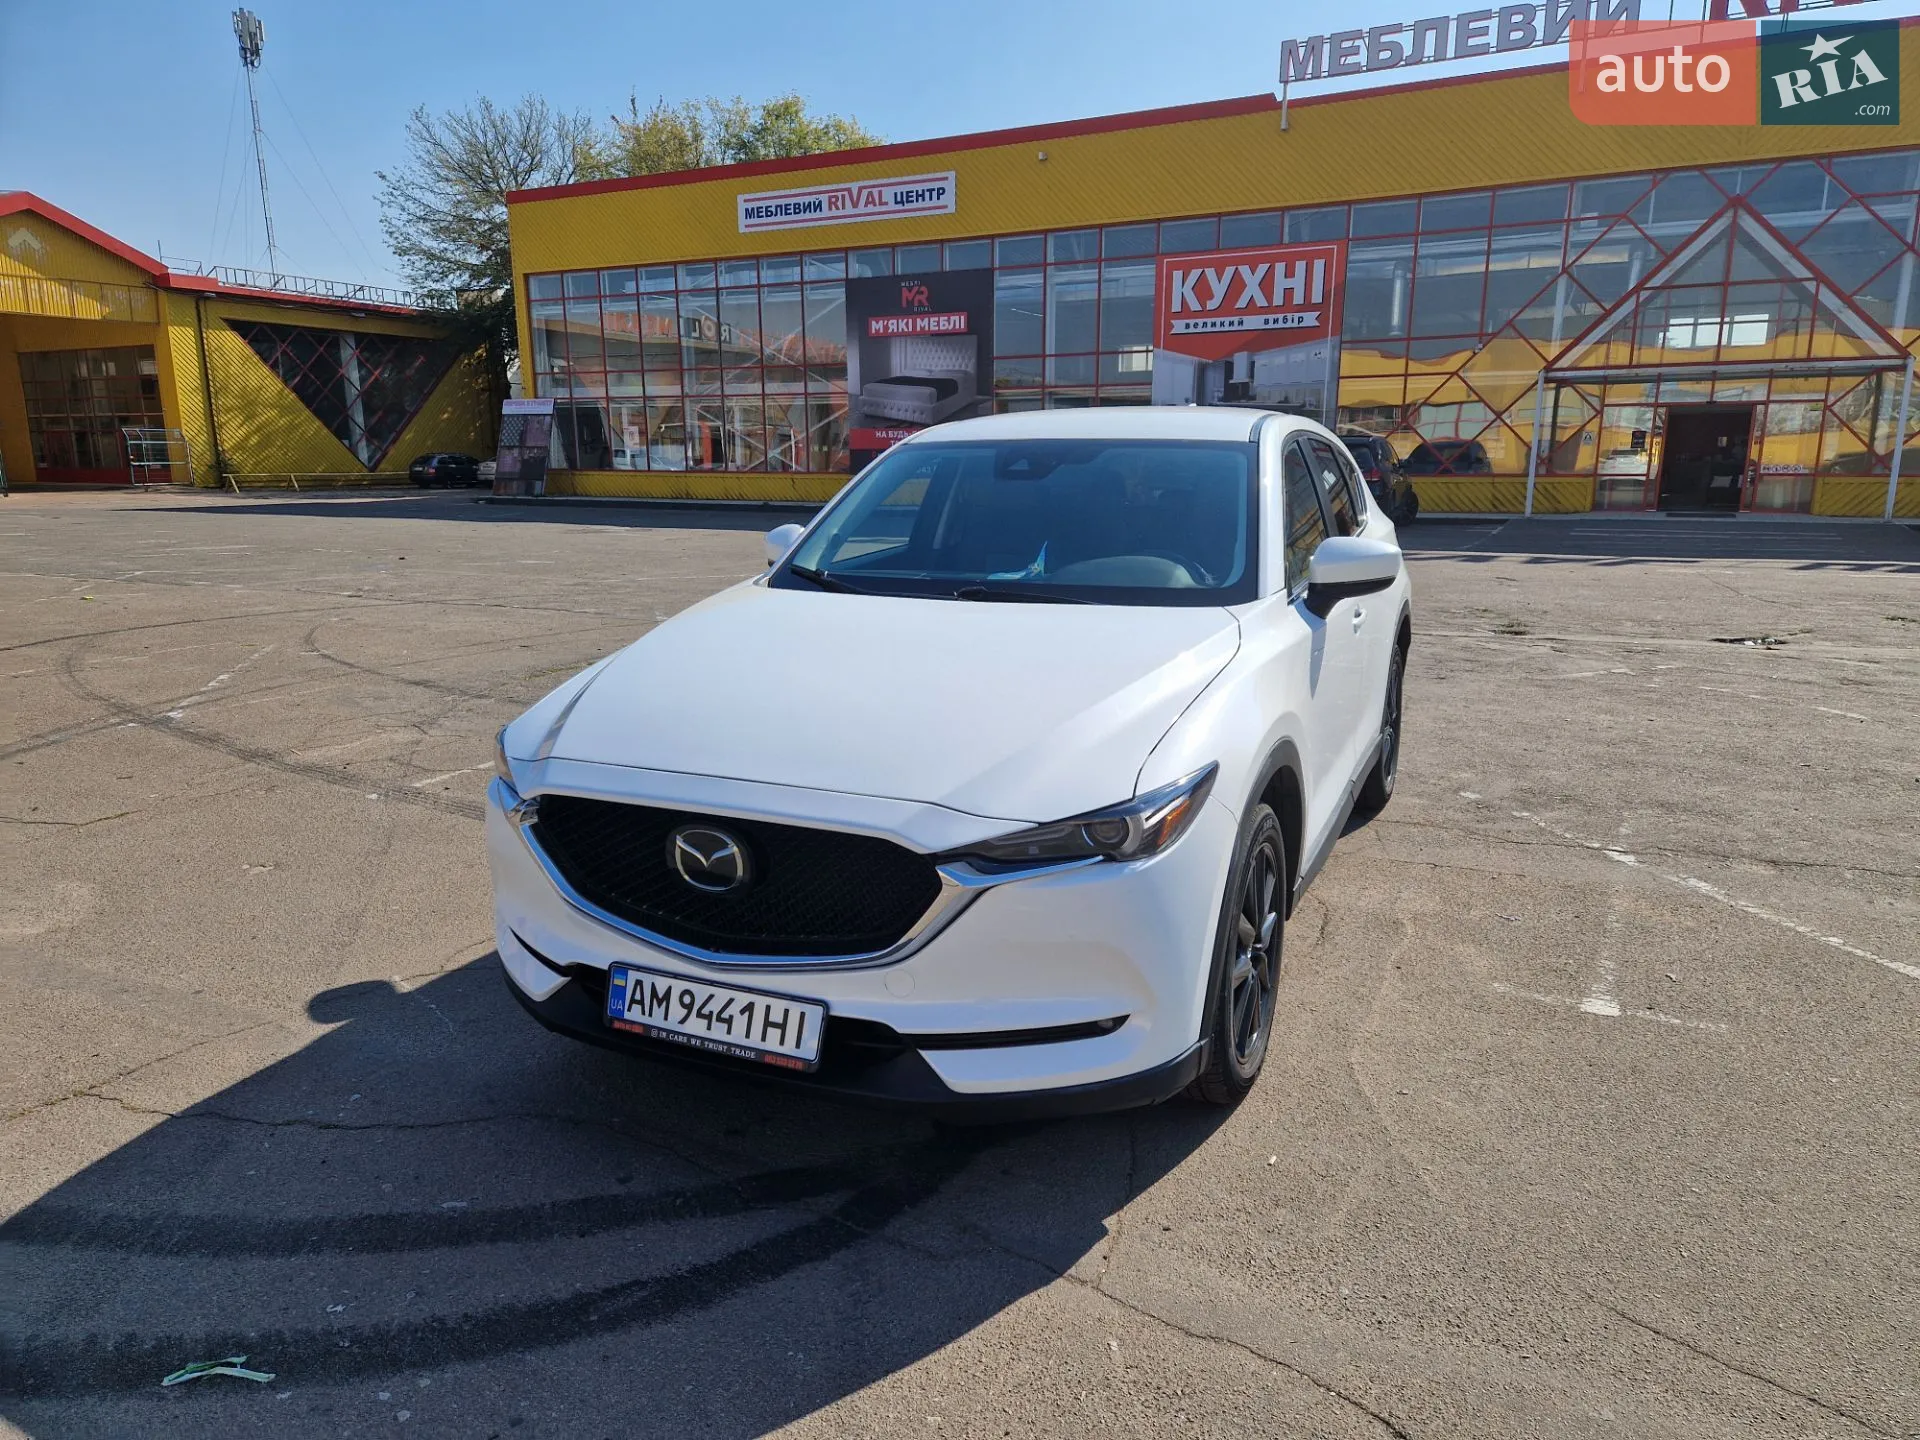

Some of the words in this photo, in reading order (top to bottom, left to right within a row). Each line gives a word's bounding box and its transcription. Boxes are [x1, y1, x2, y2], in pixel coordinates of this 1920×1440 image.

[744, 197, 823, 220] МЕБЛЕВИЙ
[827, 187, 889, 211] RIVAL
[893, 186, 946, 206] ЦЕНТР
[1171, 258, 1326, 313] КУХНІ
[916, 315, 965, 331] МЕБЛІ
[1184, 317, 1244, 330] великий
[1263, 314, 1305, 328] вибір
[875, 431, 887, 439] НА
[610, 998, 623, 1011] UA
